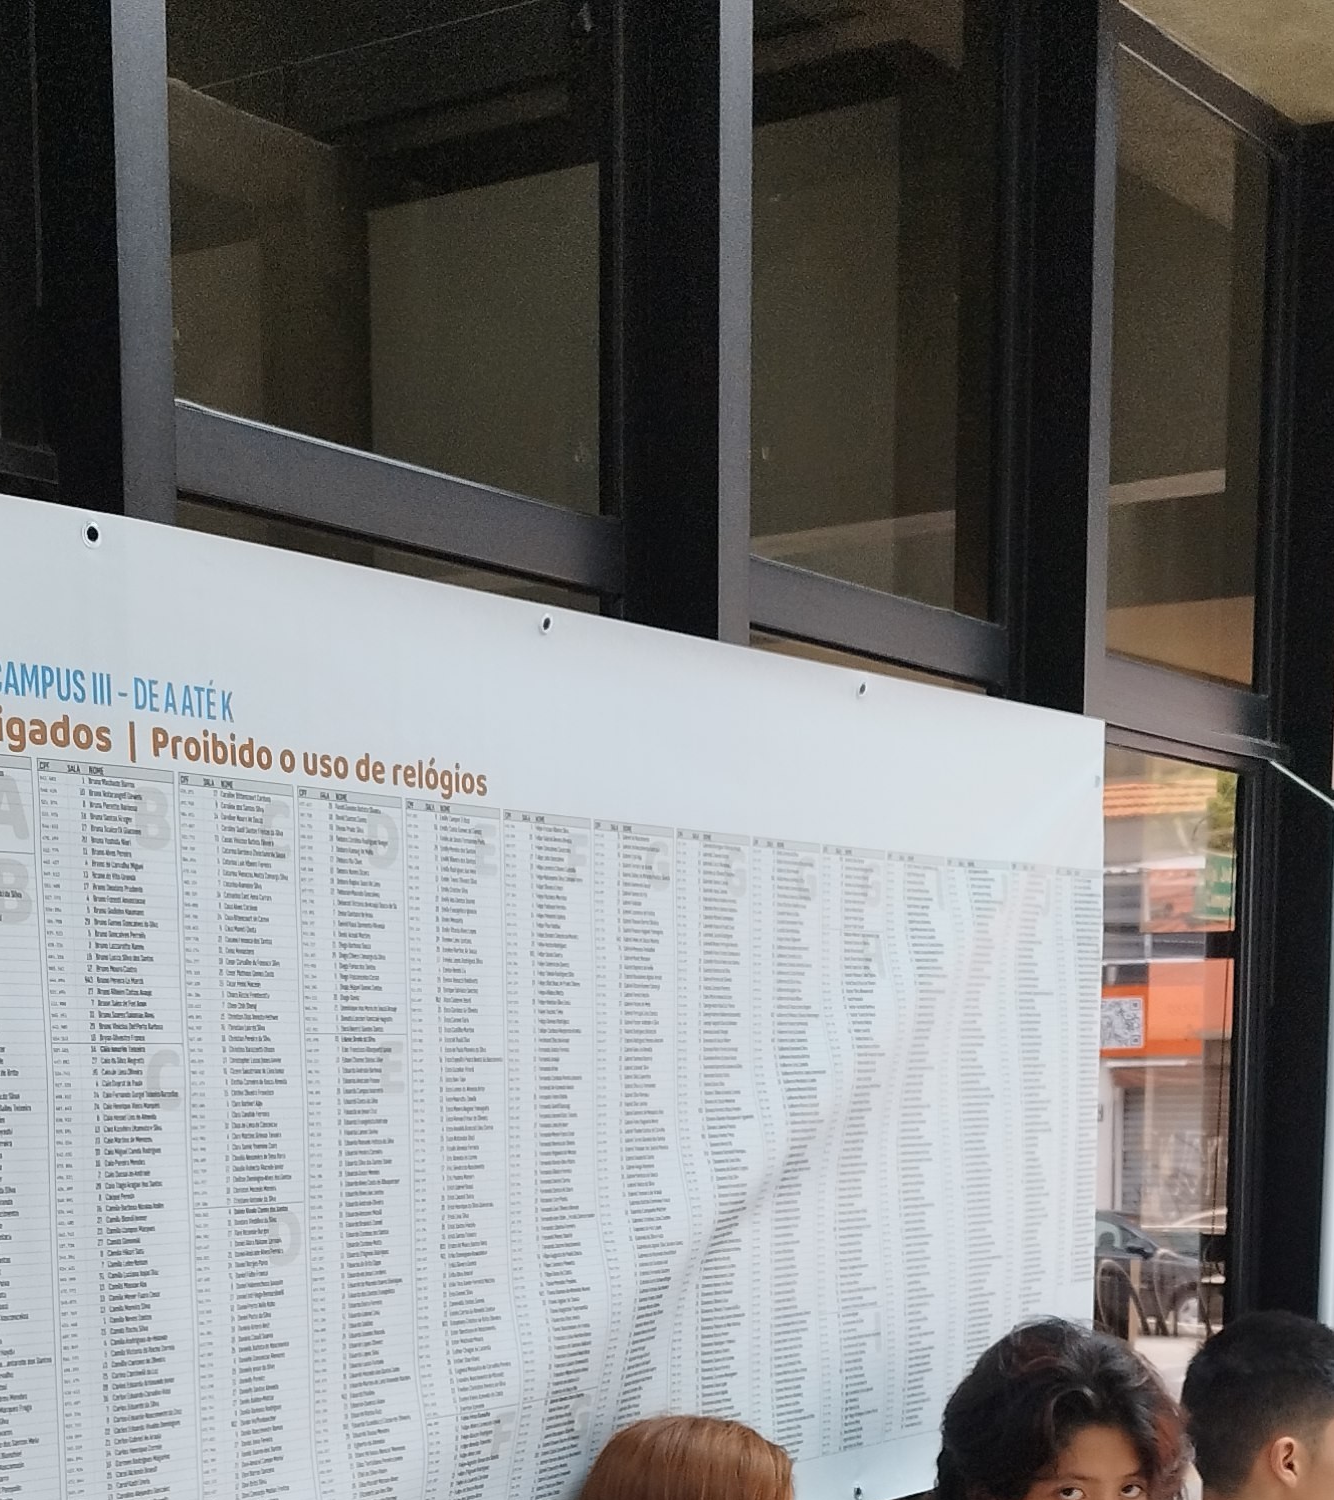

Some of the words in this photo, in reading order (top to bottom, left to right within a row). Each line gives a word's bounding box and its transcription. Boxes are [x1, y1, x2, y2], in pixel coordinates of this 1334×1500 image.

[92, 673, 111, 705] III
[134, 678, 157, 712] DE
[165, 683, 177, 713] A
[181, 680, 216, 720] ATÉ
[221, 690, 234, 722] K
[153, 728, 271, 769] Proibido
[281, 751, 295, 772] o
[304, 753, 347, 778] uso
[356, 756, 383, 782] de
[392, 759, 488, 799] relógios
